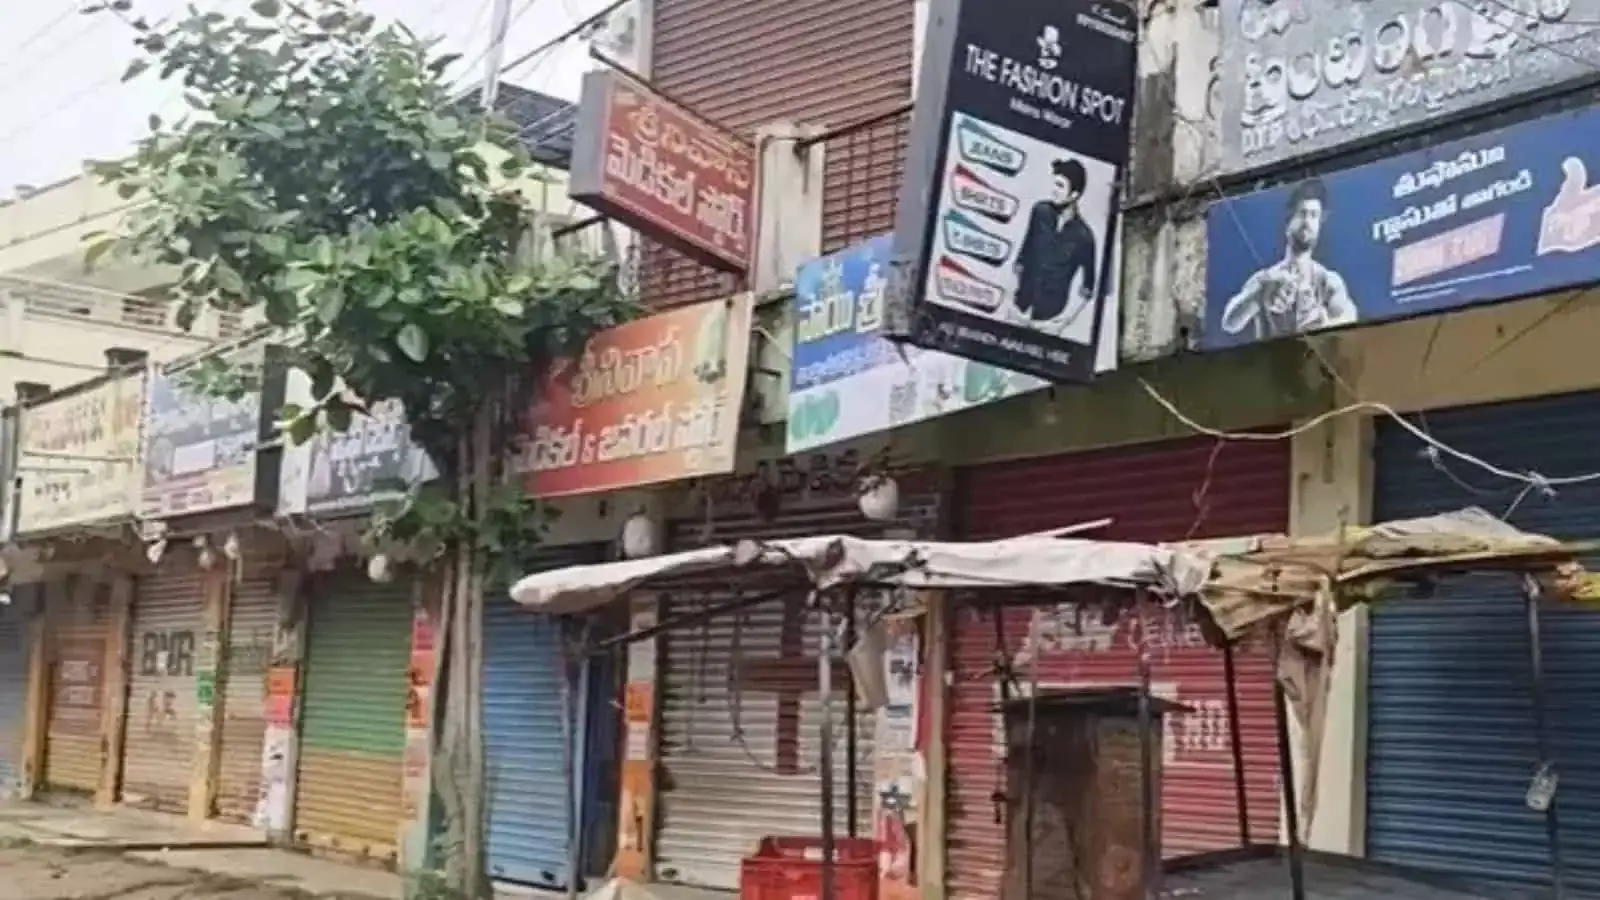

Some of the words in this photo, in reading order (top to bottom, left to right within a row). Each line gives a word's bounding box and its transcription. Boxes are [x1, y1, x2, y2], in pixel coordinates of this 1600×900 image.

[965, 43, 998, 82] THE
[1000, 56, 1079, 110] FASHION
[1080, 86, 1125, 124] SPOT
